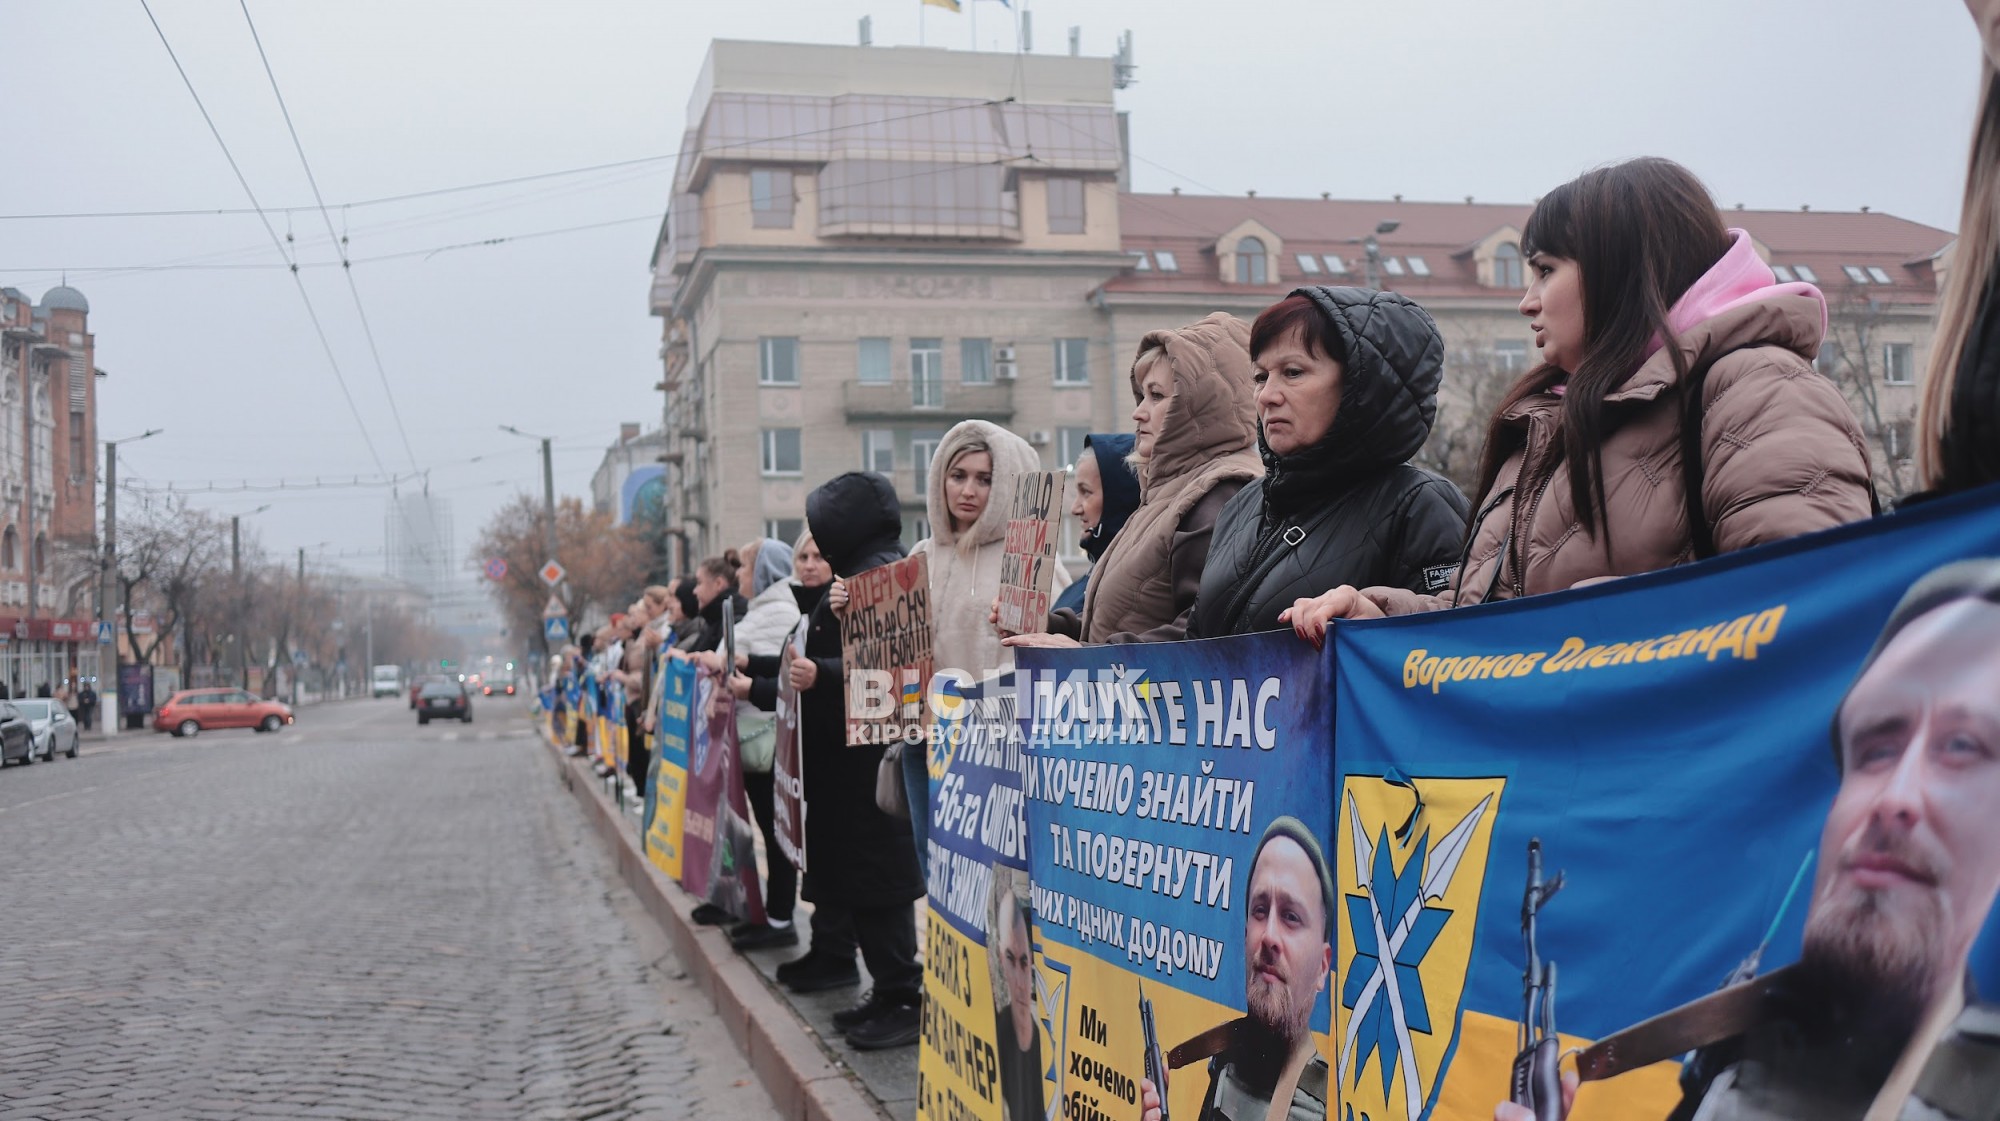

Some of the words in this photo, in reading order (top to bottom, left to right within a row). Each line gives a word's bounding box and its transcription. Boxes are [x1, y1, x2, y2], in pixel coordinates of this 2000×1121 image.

[897, 588, 926, 631] СНУ
[1403, 649, 1548, 694] Воронов
[1541, 604, 1787, 674] Олександр
[1032, 663, 1187, 745] ПОЧУЙТЕ
[1192, 677, 1281, 751] НАС
[934, 773, 982, 839] 56-та
[1042, 756, 1134, 816] ХОЧЕМО
[1136, 760, 1254, 835] ЗНАЙТИ
[1050, 823, 1074, 870] ТА
[1076, 829, 1233, 911] ПОВЕРНУТИ
[1067, 895, 1126, 949] РІДНИХ
[1128, 917, 1224, 980] ДОДОМУ
[1079, 1004, 1107, 1047] Ми
[1069, 1051, 1136, 1105] хочемо
